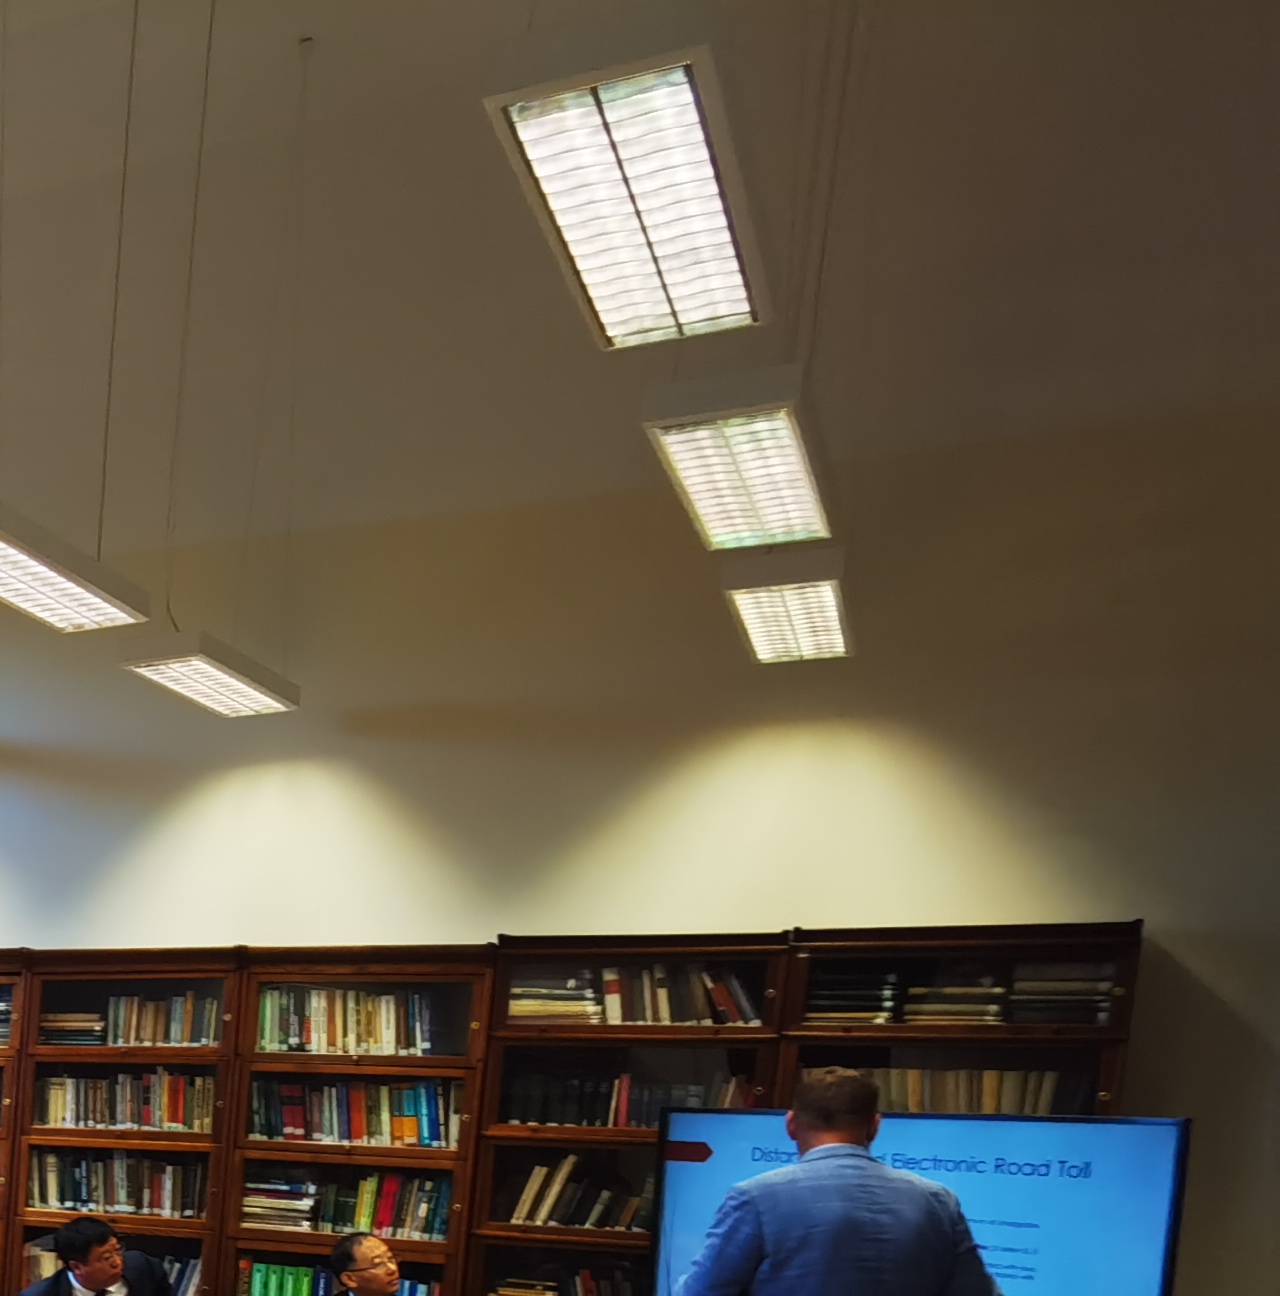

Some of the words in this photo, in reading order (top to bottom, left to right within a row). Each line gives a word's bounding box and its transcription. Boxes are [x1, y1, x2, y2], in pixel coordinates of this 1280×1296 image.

[750, 1146, 799, 1164] Distan
[891, 1152, 988, 1175] Electronic
[993, 1157, 1052, 1178] Road
[1057, 1159, 1093, 1179] Toll
